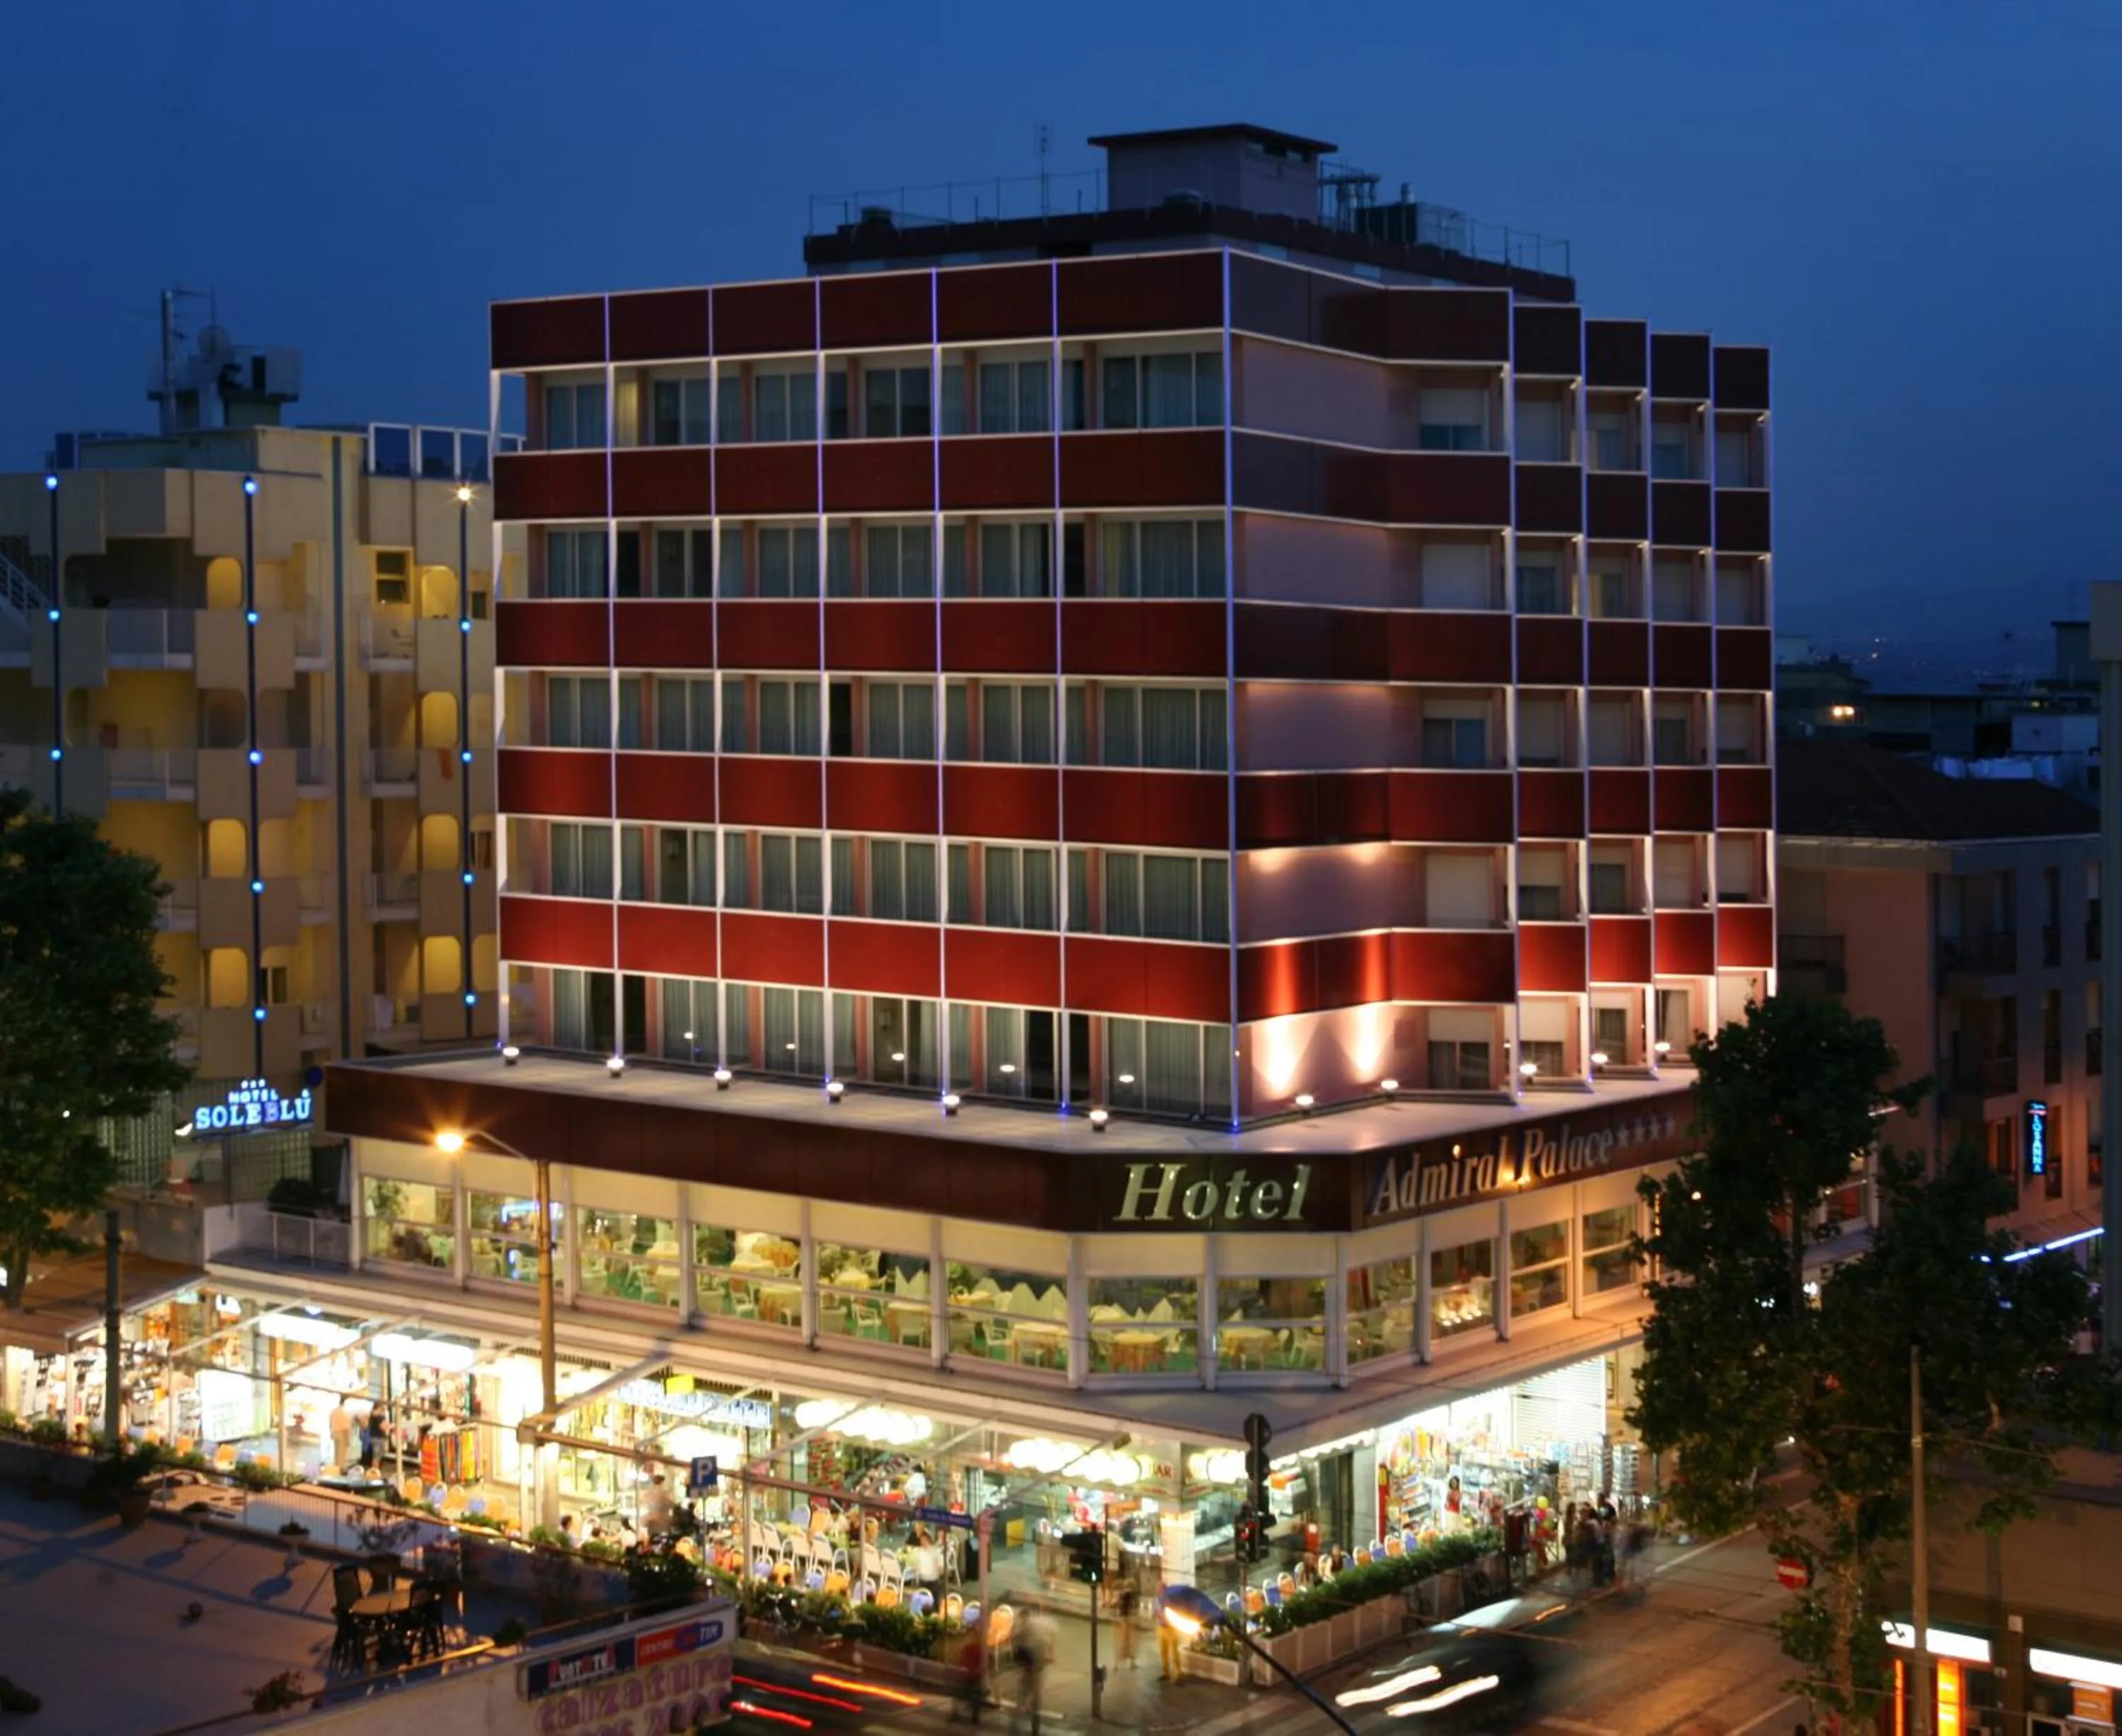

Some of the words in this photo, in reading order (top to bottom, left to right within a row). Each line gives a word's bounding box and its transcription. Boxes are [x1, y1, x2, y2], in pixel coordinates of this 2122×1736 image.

[1111, 1162, 1313, 1222] Hotel
[1369, 1135, 1509, 1215] Admiral
[1521, 1123, 1613, 1180] Palace
[697, 1459, 713, 1483] P
[699, 1624, 719, 1642] TIM
